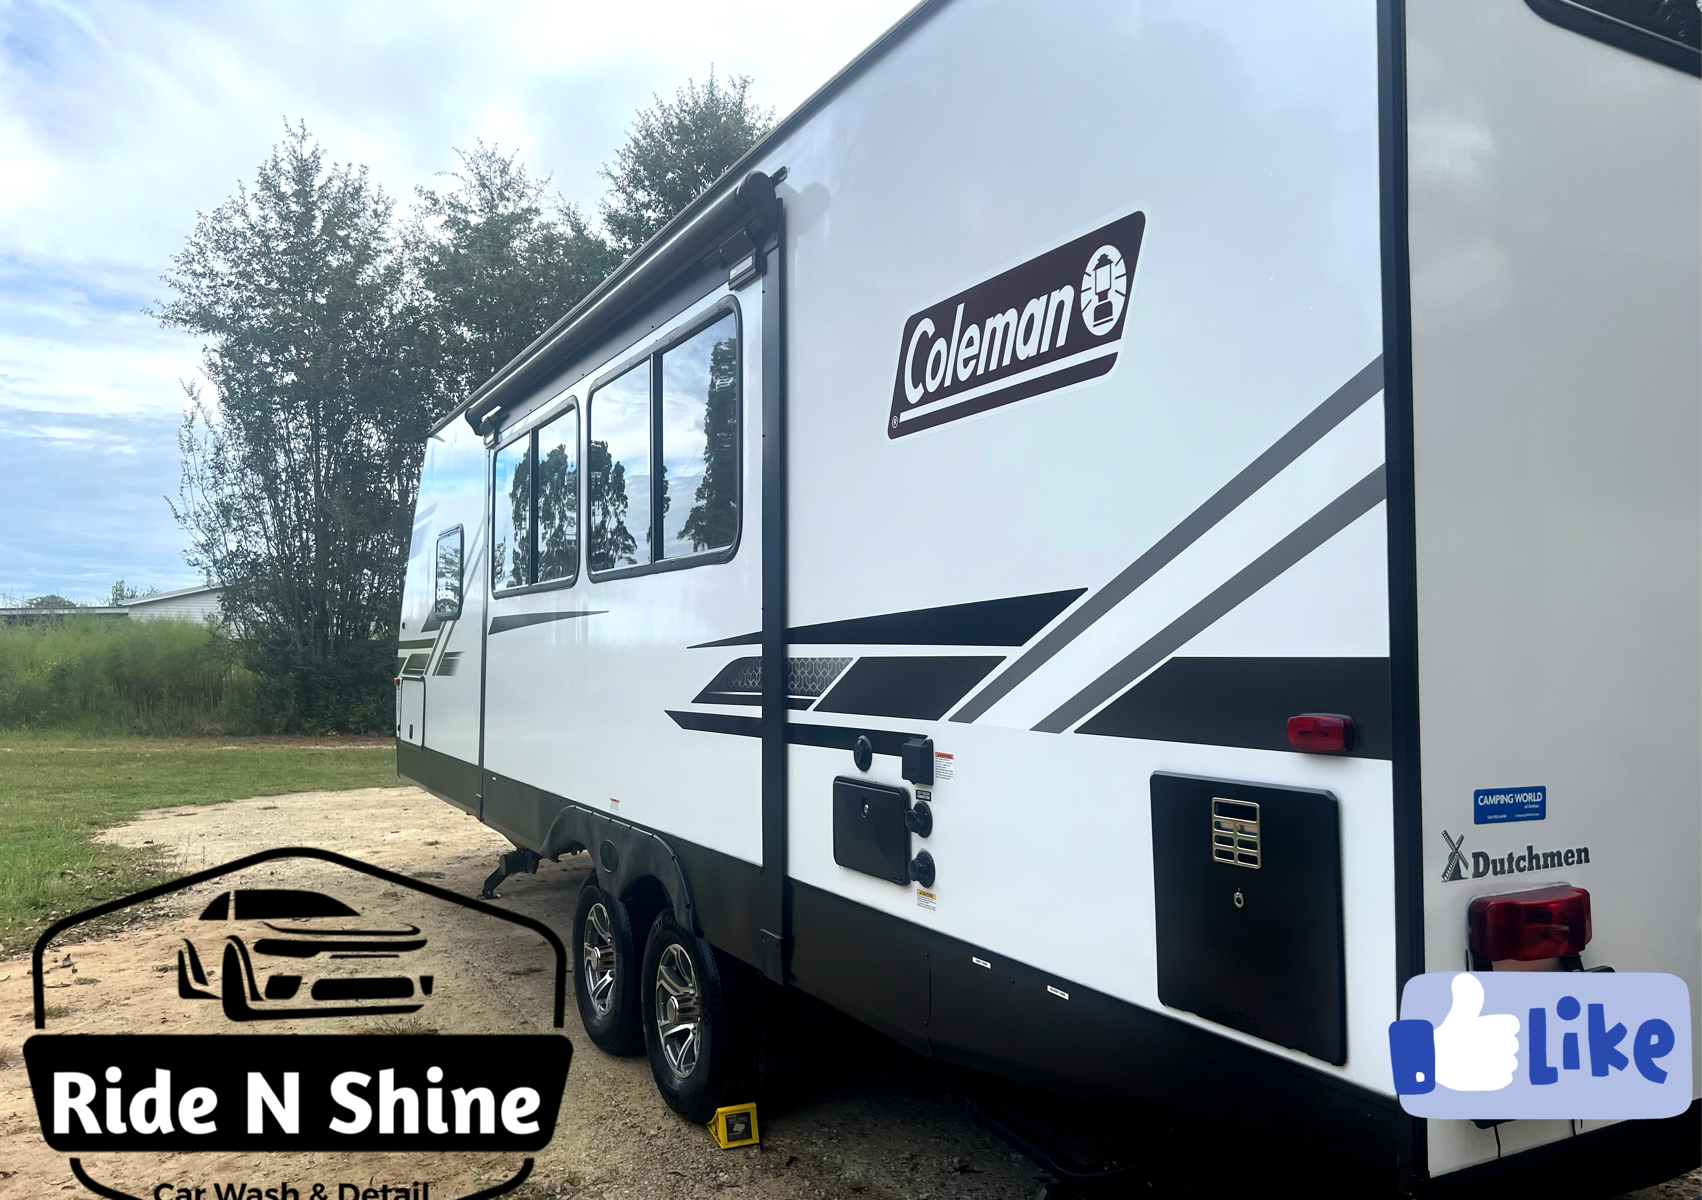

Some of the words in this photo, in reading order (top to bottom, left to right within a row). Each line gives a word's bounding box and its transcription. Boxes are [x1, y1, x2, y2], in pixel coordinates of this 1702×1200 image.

[904, 285, 1075, 404] Coleman
[1478, 794, 1513, 805] CAMPING
[1515, 792, 1543, 803] WORLD
[1472, 845, 1590, 878] Dutchmen
